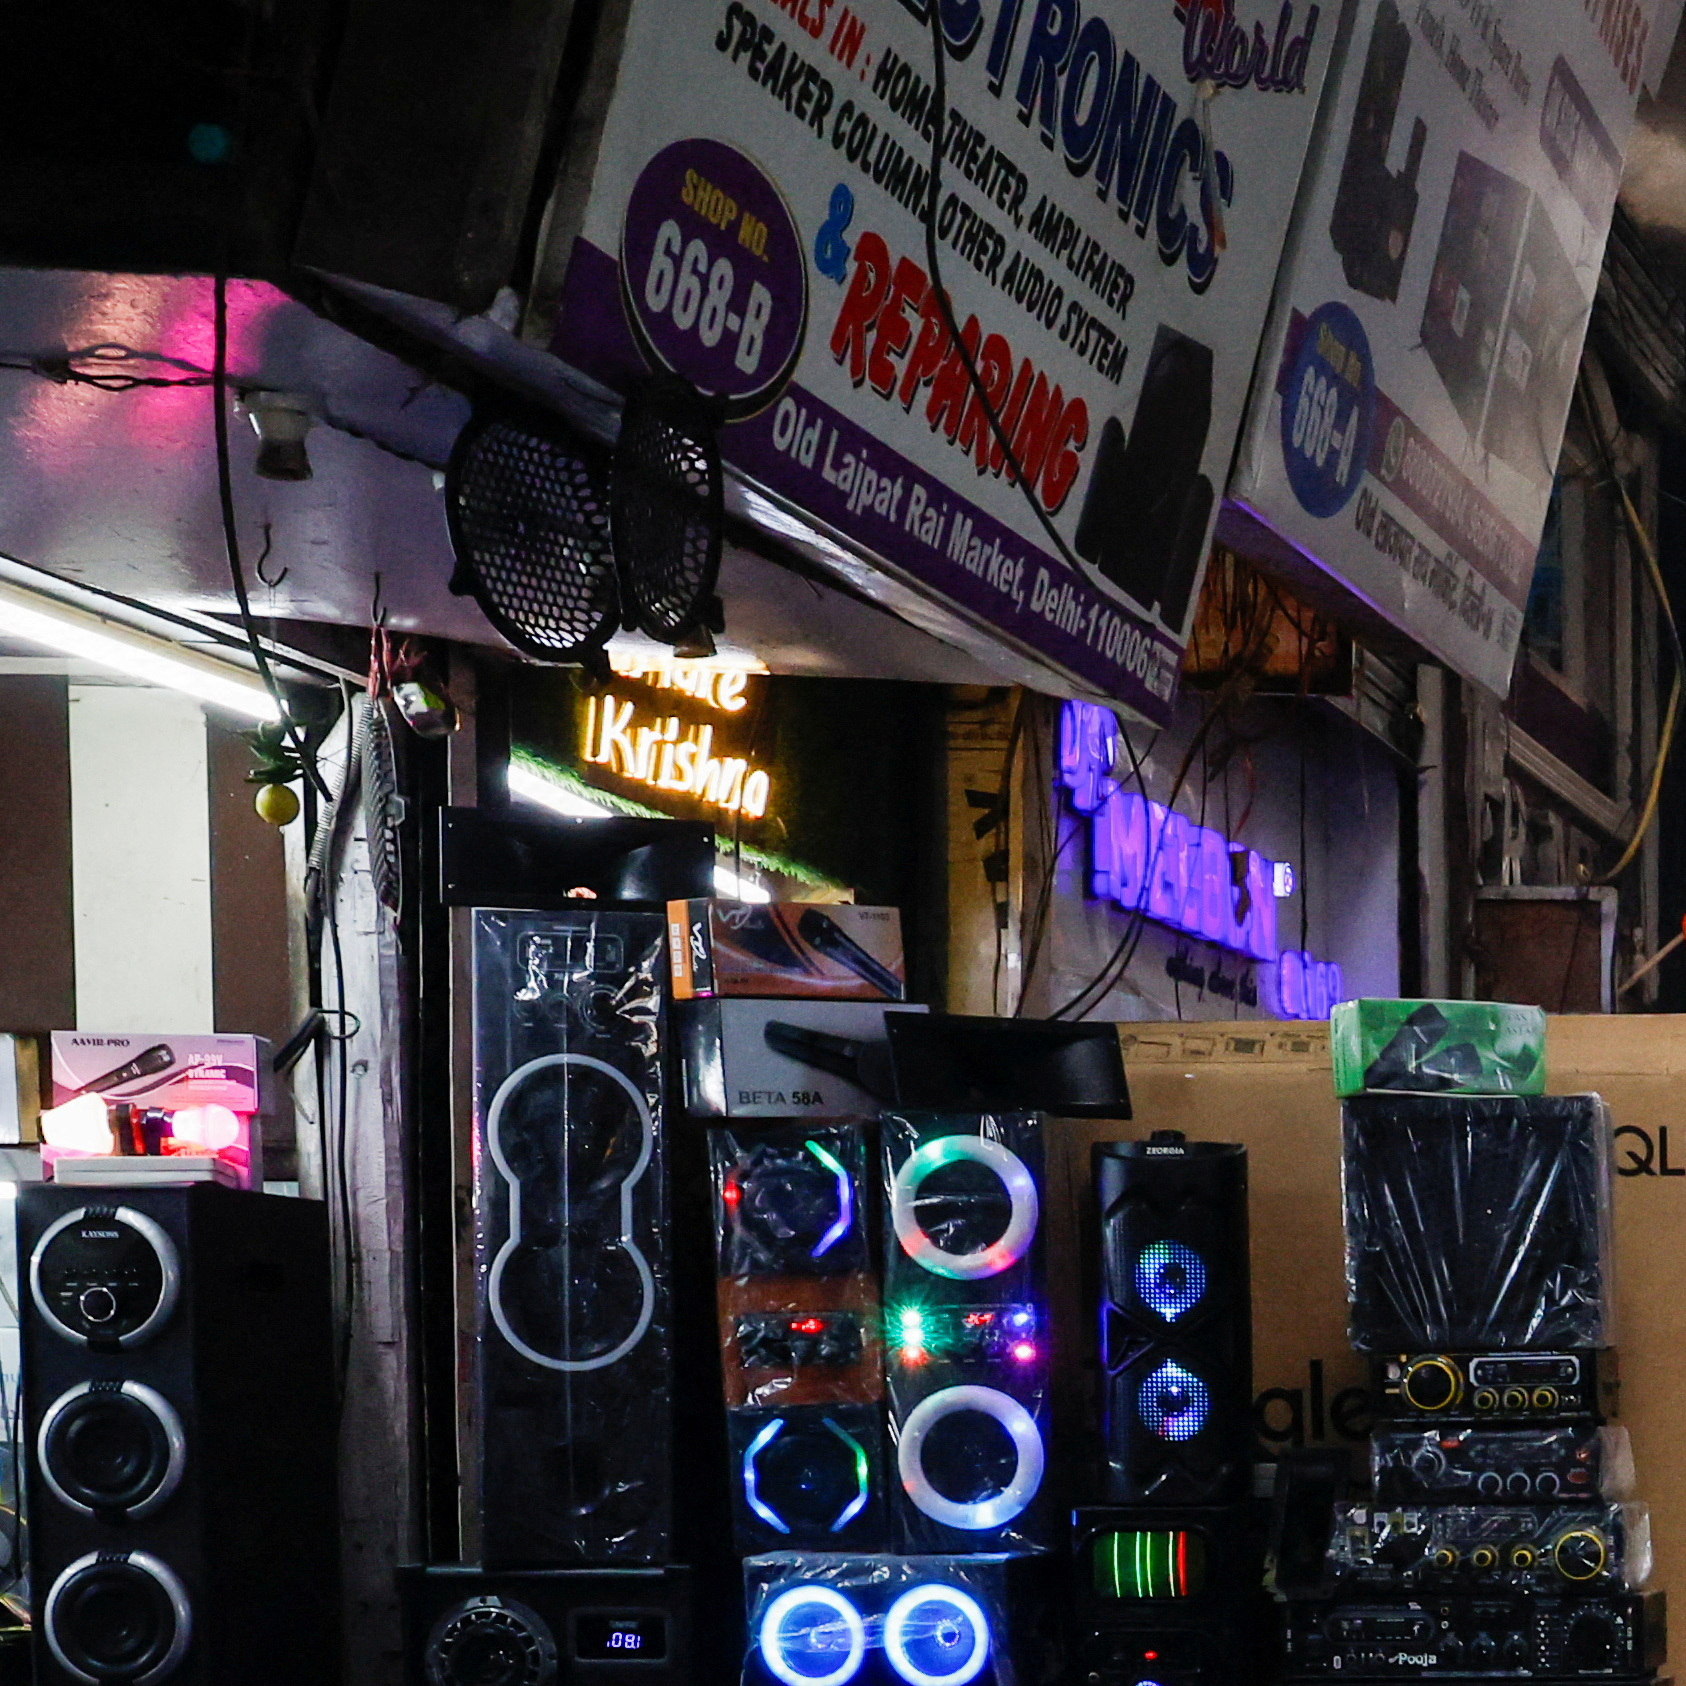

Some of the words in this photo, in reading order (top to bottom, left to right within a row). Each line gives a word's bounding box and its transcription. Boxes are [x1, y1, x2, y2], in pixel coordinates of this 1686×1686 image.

[829, 7, 866, 70] IN
[681, 168, 738, 241] SHOP
[714, 1, 835, 139] SPEAKER
[937, 193, 1006, 288] OTHER
[1001, 249, 1061, 331] AUDIO
[1062, 303, 1130, 385] SYSTEM
[814, 183, 854, 285] &
[644, 219, 773, 375] 668-B
[772, 396, 816, 471] Old
[822, 430, 904, 528] Lajpat
[904, 481, 948, 546] Rai
[947, 514, 1026, 610] Market,
[1031, 573, 1157, 684] Delhi-110006
[738, 1091, 787, 1105] BETA
[791, 1091, 825, 1106] 58A
